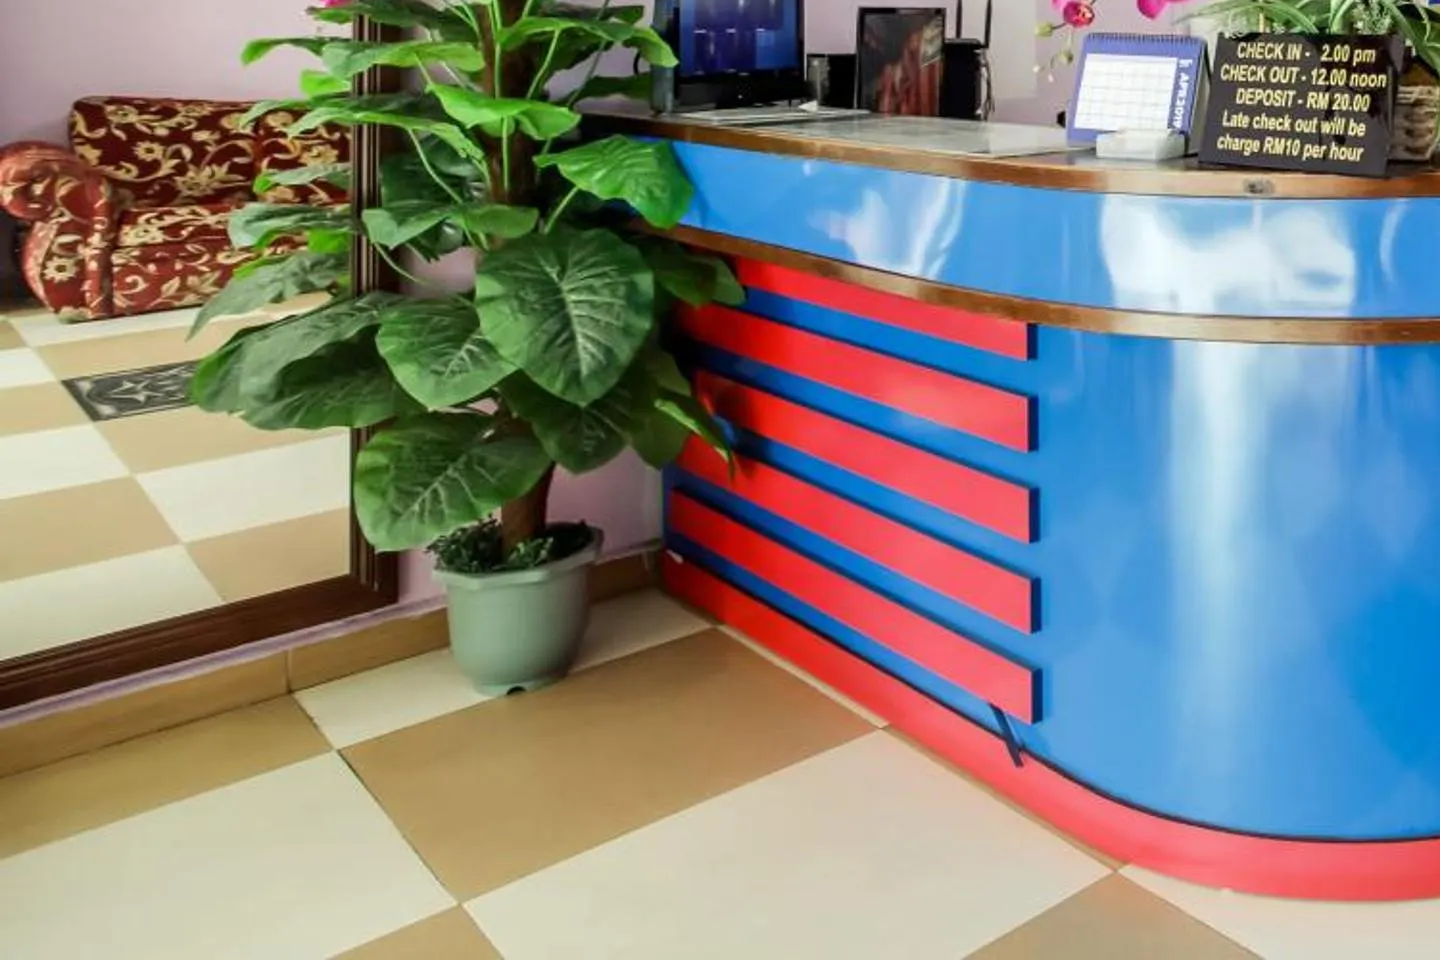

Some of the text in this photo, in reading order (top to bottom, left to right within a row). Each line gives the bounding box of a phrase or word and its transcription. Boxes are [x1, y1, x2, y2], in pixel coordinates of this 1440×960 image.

[1237, 41, 1284, 62] CHECK
[1287, 43, 1302, 61] IN
[1320, 43, 1350, 63] 2.00
[1352, 47, 1376, 66] pm
[1220, 64, 1266, 83] CHECK
[1269, 66, 1299, 84] OUT
[1311, 68, 1347, 86] 12.00
[1350, 73, 1387, 88] noon
[1236, 88, 1296, 107] DEPOSIT
[1306, 92, 1328, 110] RM
[1332, 93, 1371, 112] 20.00
[1222, 110, 1366, 136] Late check out will be
[1217, 135, 1364, 161] charge RM10 per hour
